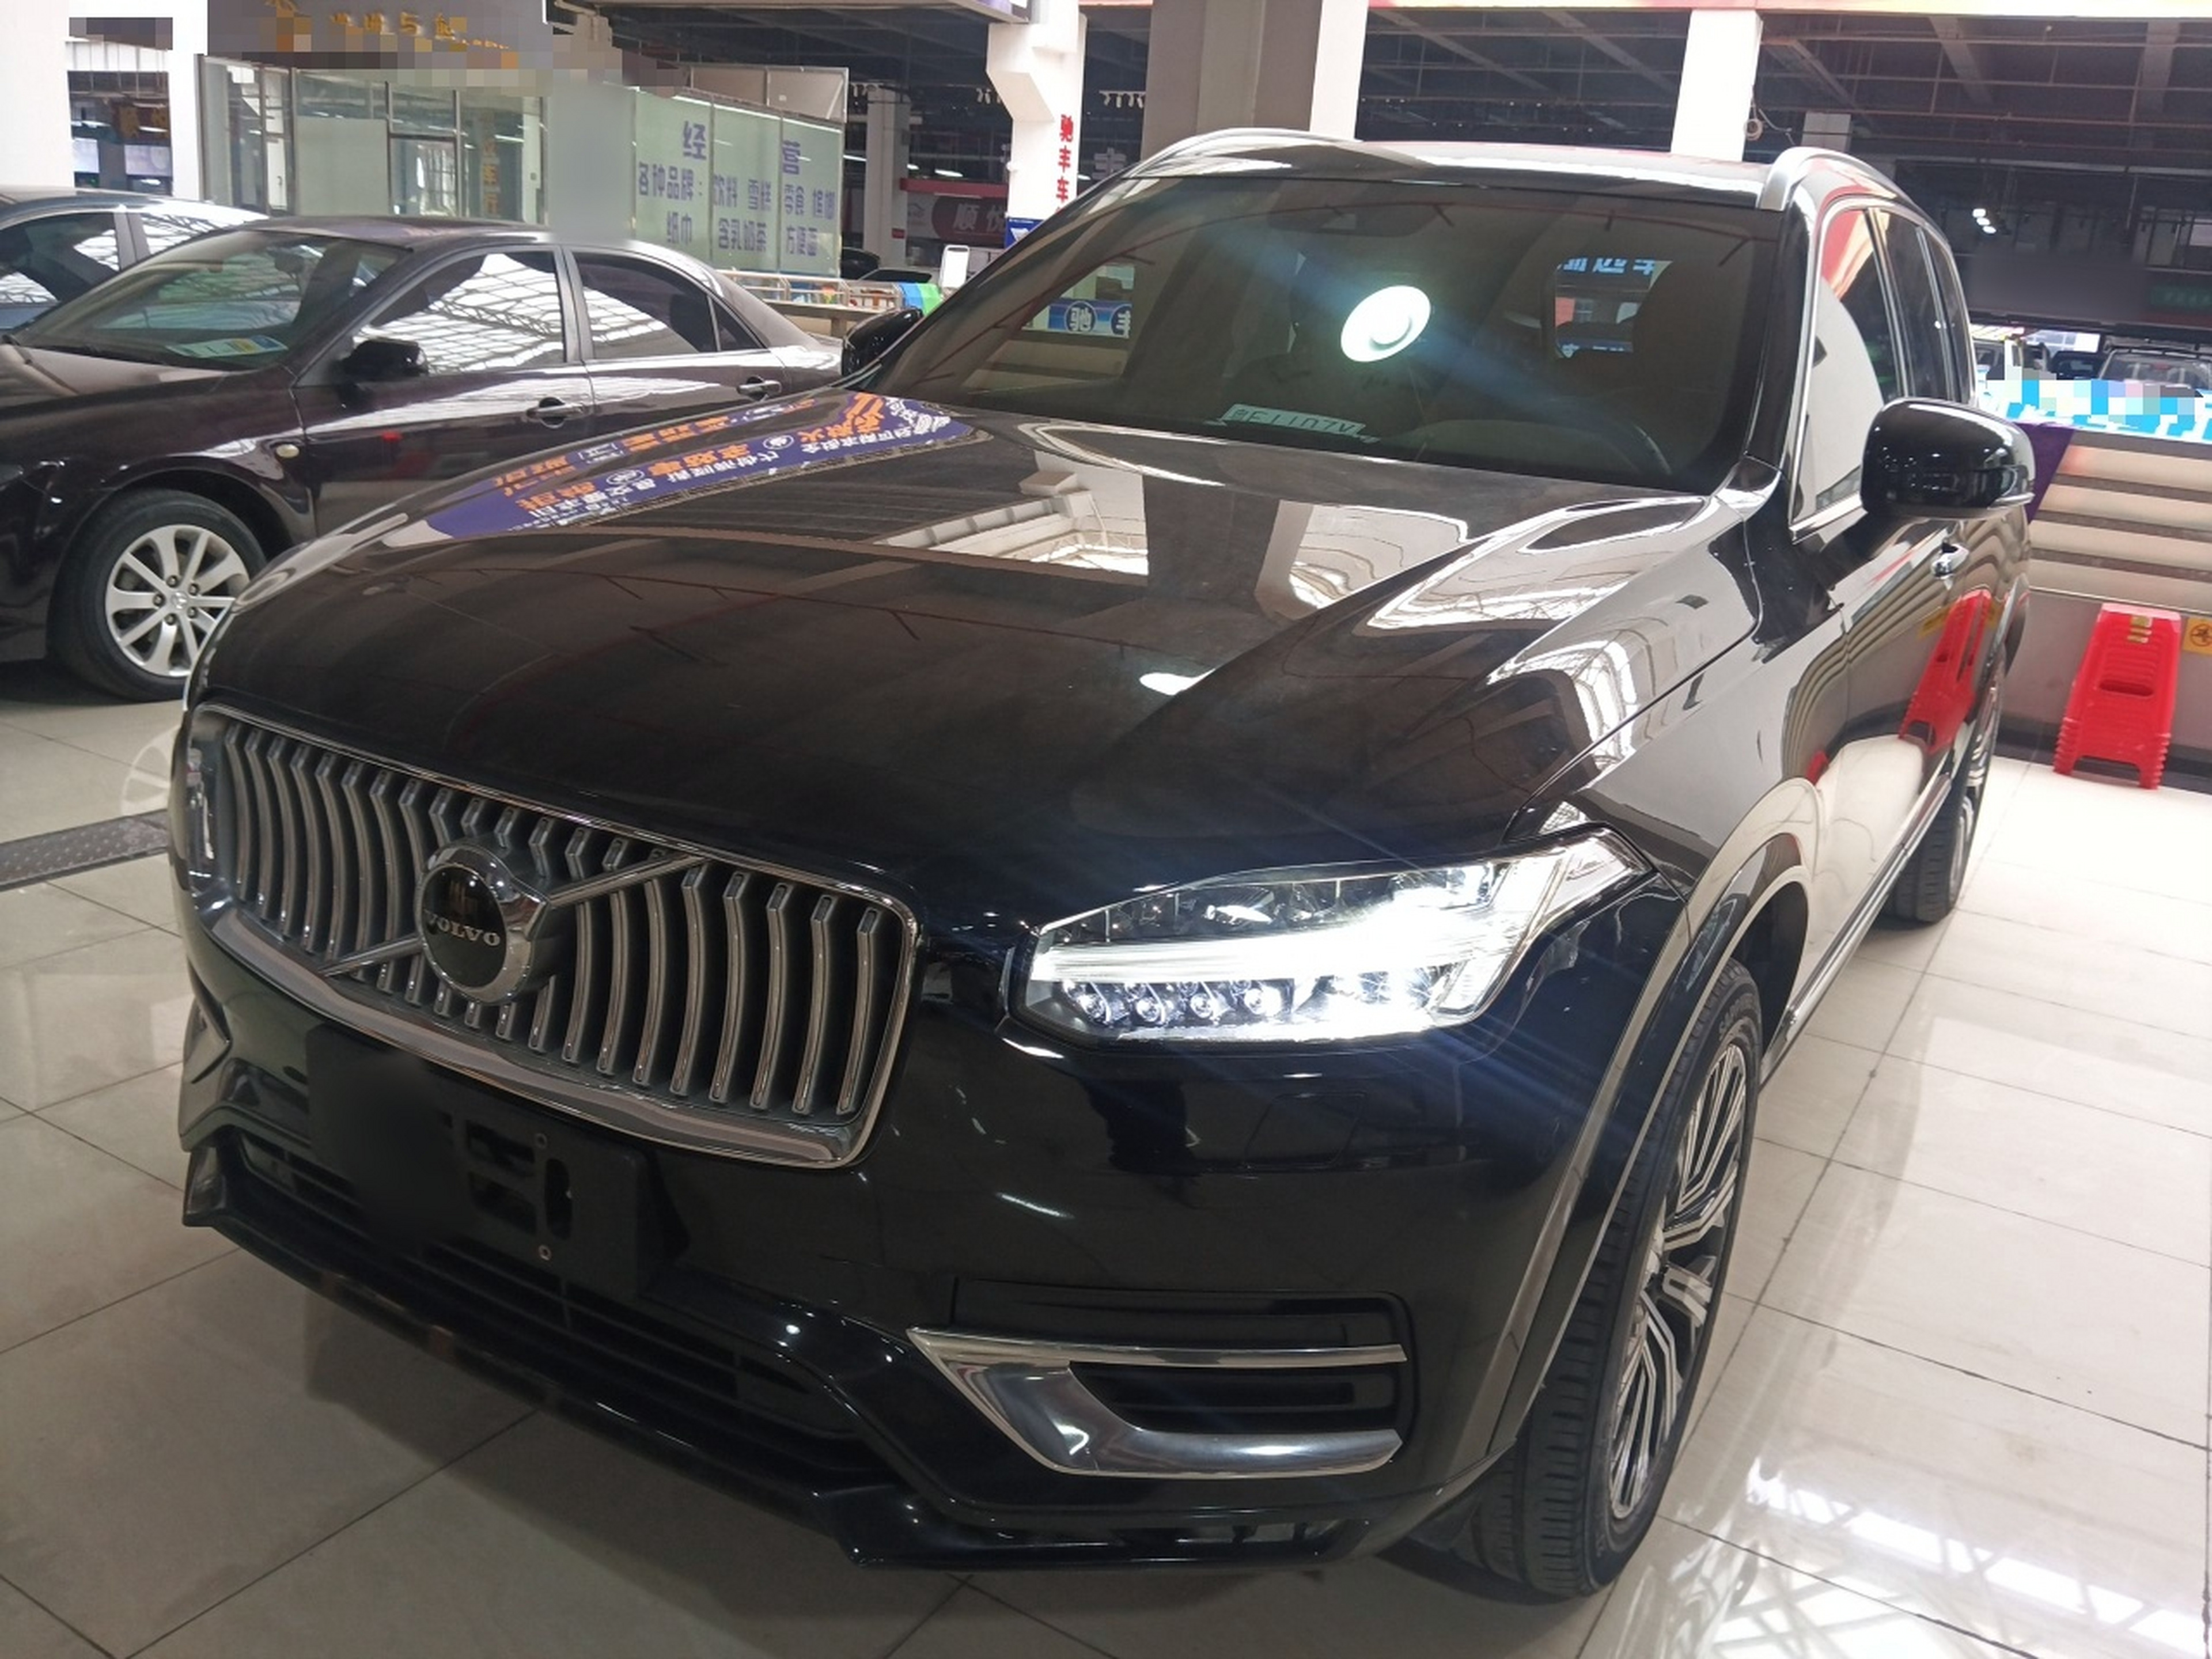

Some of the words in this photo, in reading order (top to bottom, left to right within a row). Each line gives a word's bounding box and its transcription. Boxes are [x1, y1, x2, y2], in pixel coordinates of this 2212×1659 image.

[683, 120, 707, 160] 经
[782, 140, 801, 175] 营
[423, 910, 501, 946] VOLVO
